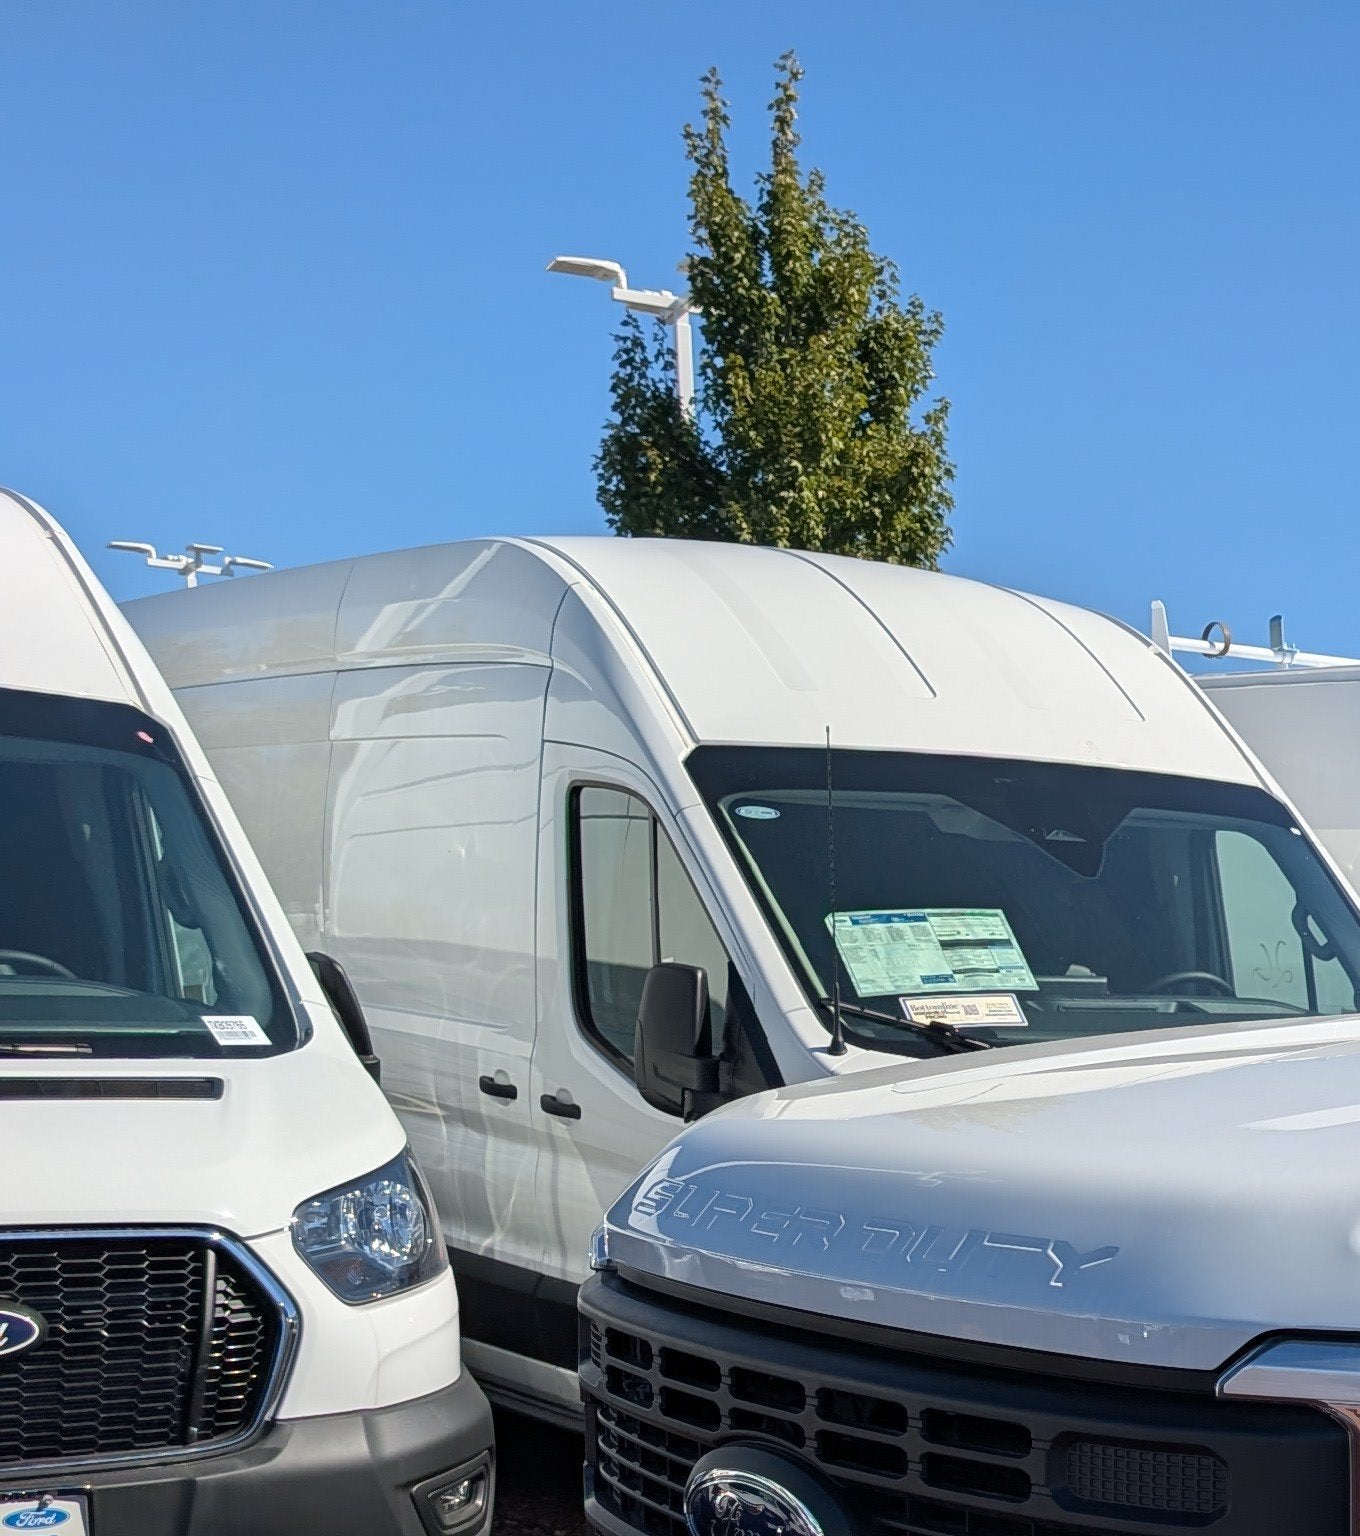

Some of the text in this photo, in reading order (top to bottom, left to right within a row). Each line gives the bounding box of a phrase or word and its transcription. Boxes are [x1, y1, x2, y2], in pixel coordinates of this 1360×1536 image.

[633, 1178, 1121, 1287] SUPER DUTY
[16, 1510, 57, 1527] Ford
